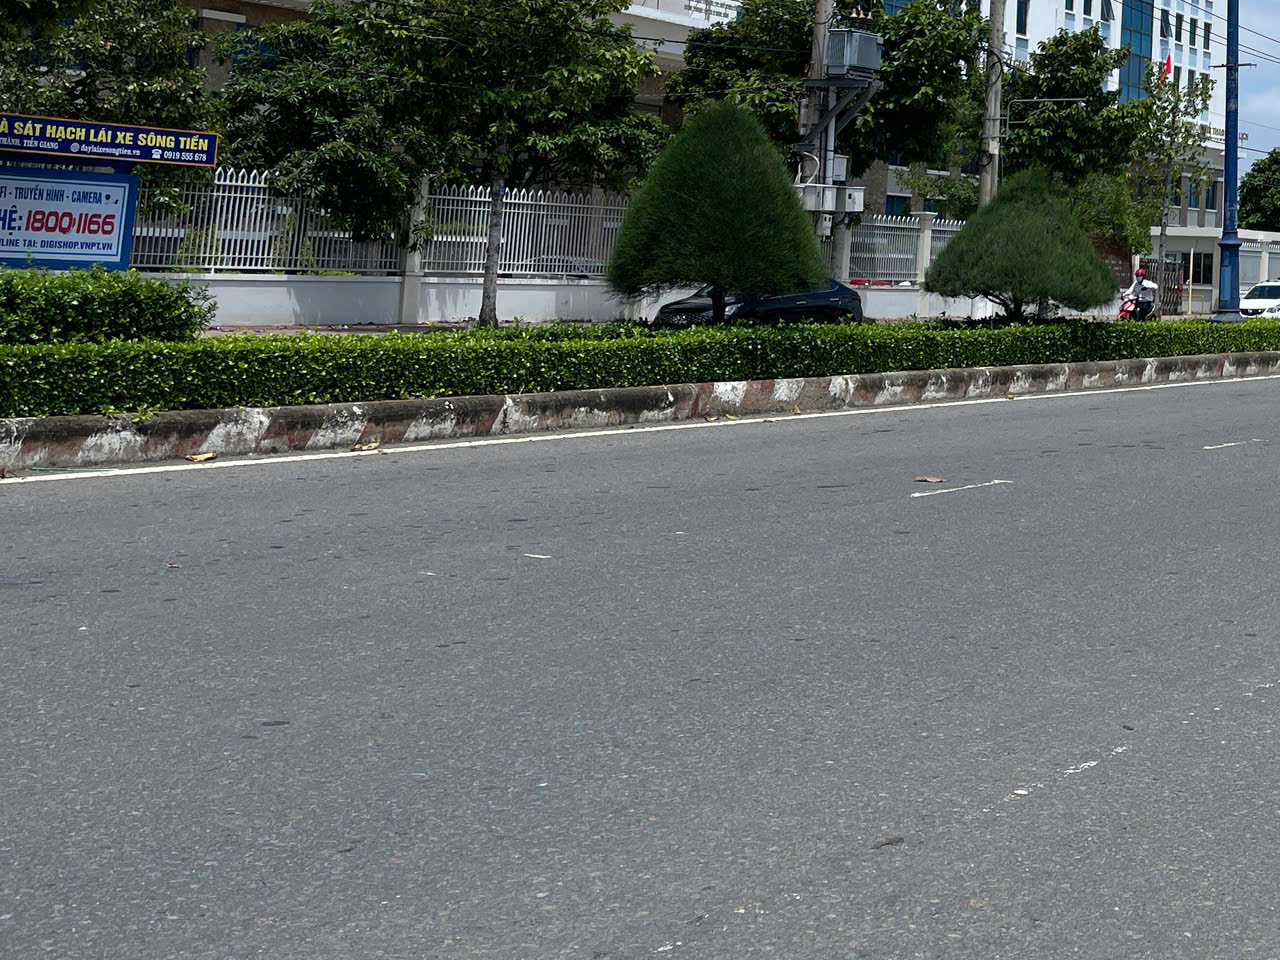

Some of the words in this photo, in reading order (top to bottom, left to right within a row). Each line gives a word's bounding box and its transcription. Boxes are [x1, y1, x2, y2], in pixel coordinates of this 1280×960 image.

[13, 121, 43, 136] SÁT
[45, 125, 86, 142] HẠCH
[89, 127, 112, 143] LÁI
[115, 132, 134, 145] XE
[137, 132, 176, 149] SÔNG
[39, 141, 59, 150] GIANG
[163, 150, 181, 160] 0919
[181, 152, 194, 161] 555
[194, 153, 207, 162] 678
[45, 186, 65, 203] HÌNH
[71, 190, 102, 205] CAMERA
[0, 238, 20, 248] LINE
[22, 239, 38, 250] TẠI:
[40, 240, 113, 251] DIGISHOP.VNPT.VN
